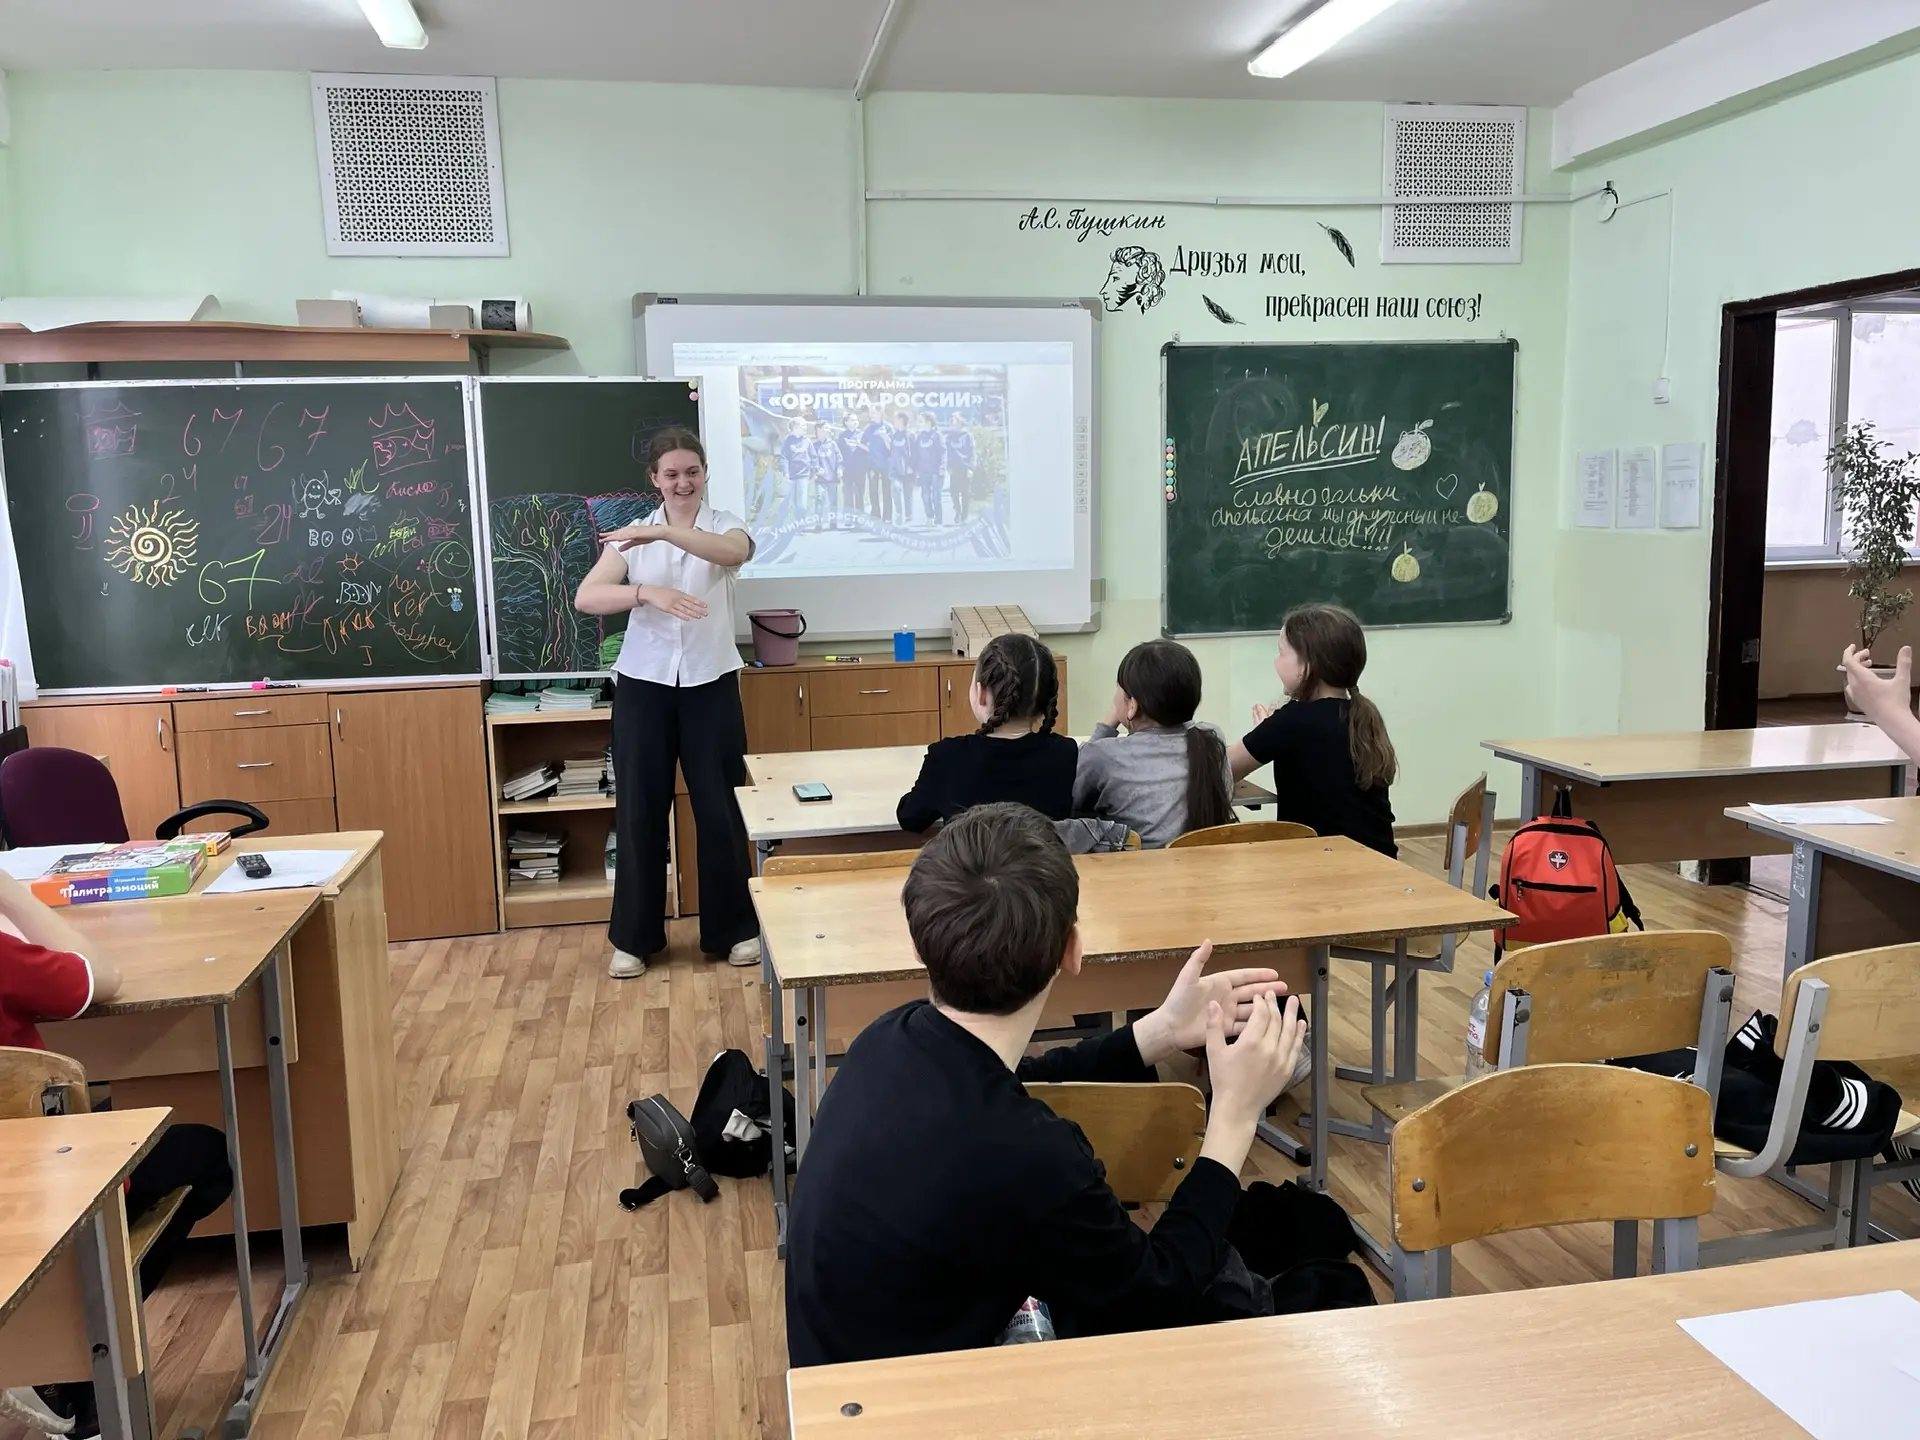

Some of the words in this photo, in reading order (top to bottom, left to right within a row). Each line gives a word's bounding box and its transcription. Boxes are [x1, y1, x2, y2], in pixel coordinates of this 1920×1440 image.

[1019, 206, 1061, 230] А.С.
[1066, 208, 1166, 243] Пушкин
[1169, 245, 1247, 278] Друзья
[1259, 252, 1306, 276] мои,
[1265, 294, 1369, 323] прекрасен
[1376, 296, 1420, 318] наш
[1425, 293, 1482, 323] союз!
[838, 380, 914, 390] ПРОГРАММА
[769, 392, 870, 410] «ОРЛЯТА
[879, 391, 984, 409] РОССИИ»
[1233, 415, 1386, 480] АПЕЛЬСИН!
[60, 884, 112, 898] Палитра
[114, 880, 159, 893] эмоций
